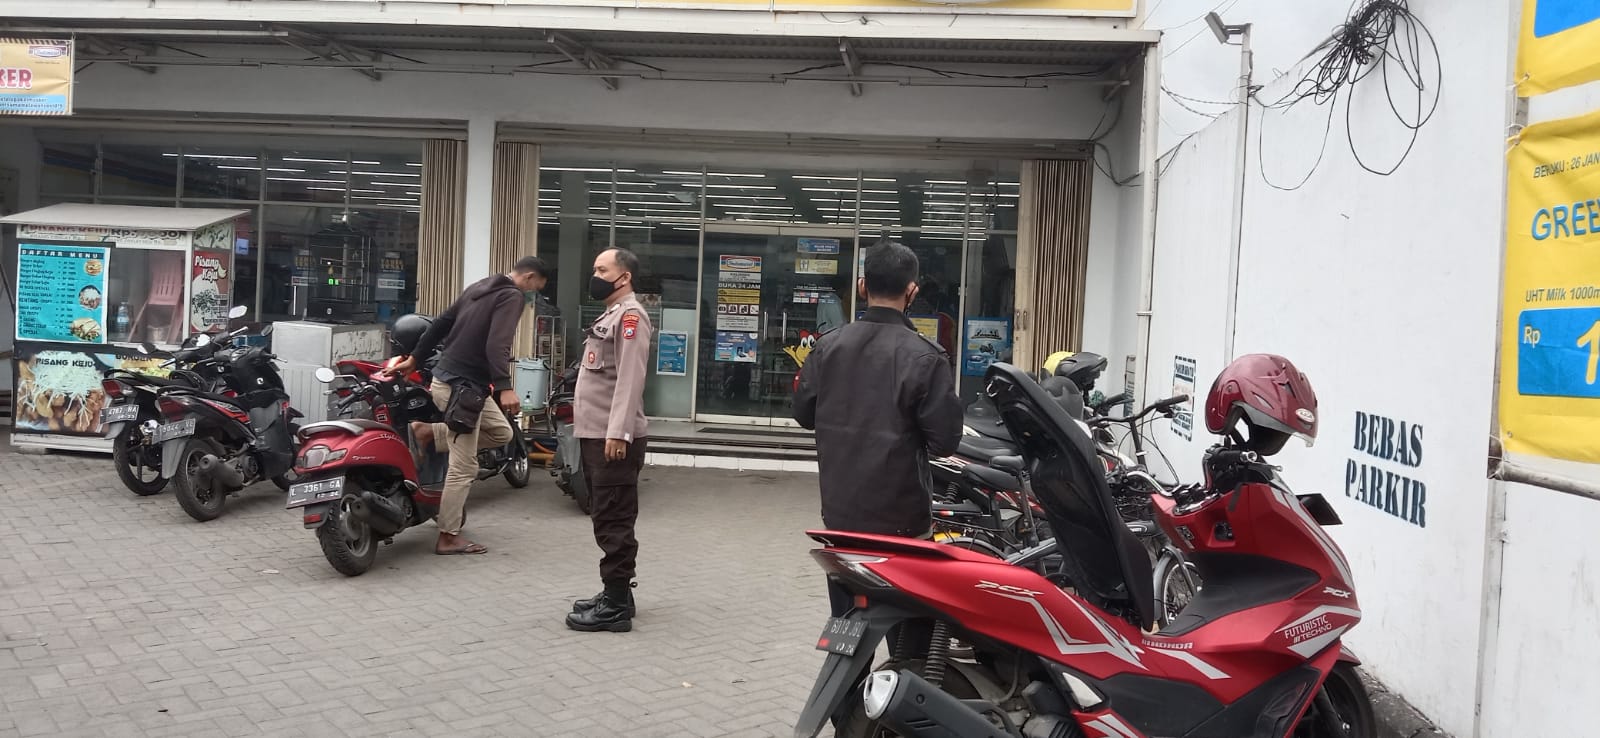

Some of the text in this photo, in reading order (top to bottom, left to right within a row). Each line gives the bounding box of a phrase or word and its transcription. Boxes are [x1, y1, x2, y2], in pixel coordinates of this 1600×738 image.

[1571, 157, 1581, 170] 26
[1531, 198, 1600, 241] GREE
[22, 249, 63, 257] DAFTAR
[194, 255, 220, 268] Pisang
[202, 268, 219, 283] Keju
[1525, 288, 1544, 302] UHT
[1546, 288, 1566, 301] Milk
[1523, 325, 1541, 348] Rp
[35, 358, 94, 368] PISANG KEJU
[1353, 411, 1424, 468] BEBAS
[1345, 458, 1427, 529] PARKIR
[975, 580, 1044, 598] PCX
[1322, 587, 1351, 599] PCX
[1284, 614, 1329, 639] FUTURISTIC
[1302, 623, 1332, 641] TECHNO
